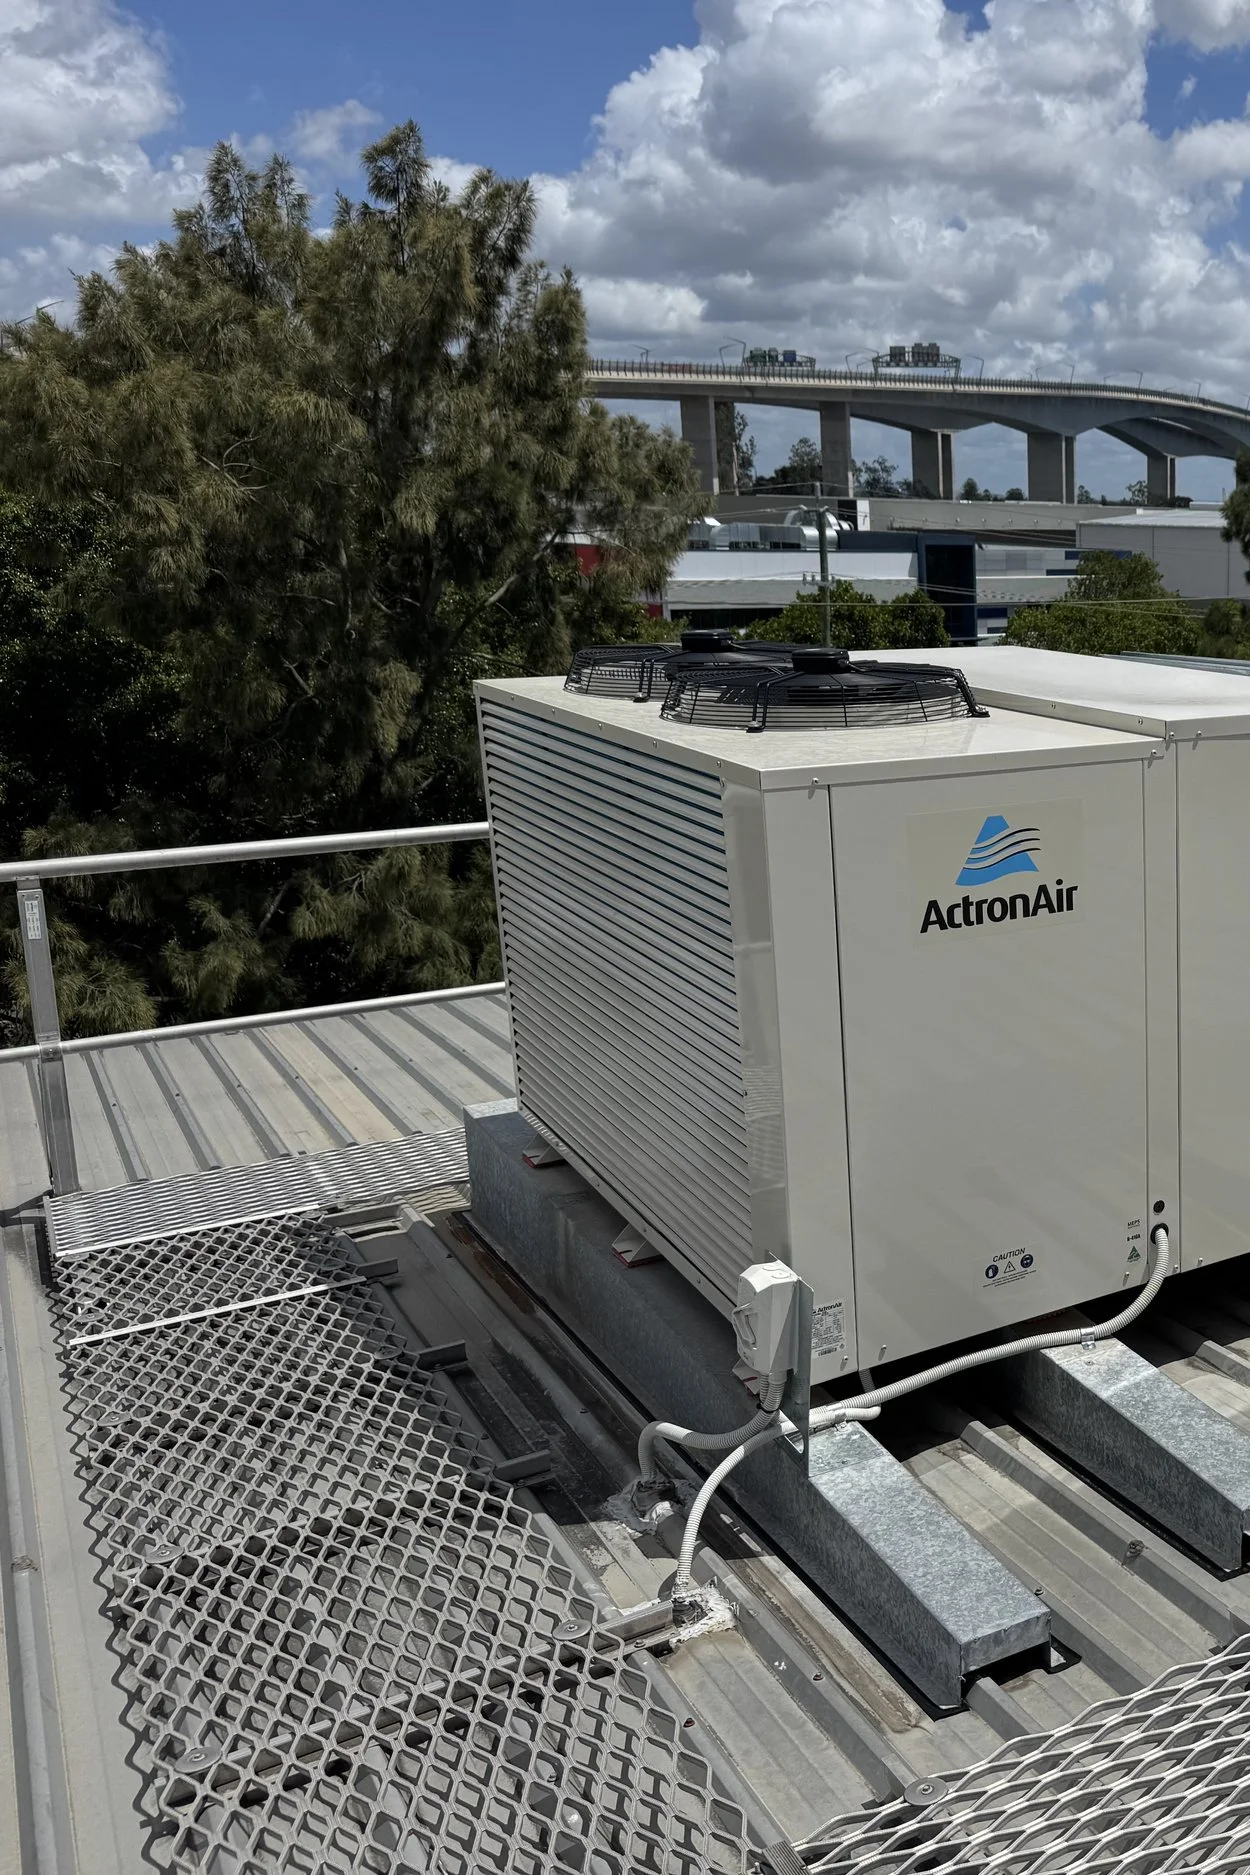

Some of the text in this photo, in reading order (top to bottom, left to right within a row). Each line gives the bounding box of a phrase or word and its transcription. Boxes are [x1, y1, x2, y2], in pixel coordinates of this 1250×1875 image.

[920, 878, 1079, 934] ActronAir
[992, 1247, 1026, 1263] CAUTION
[817, 1302, 843, 1313] ActronAir
